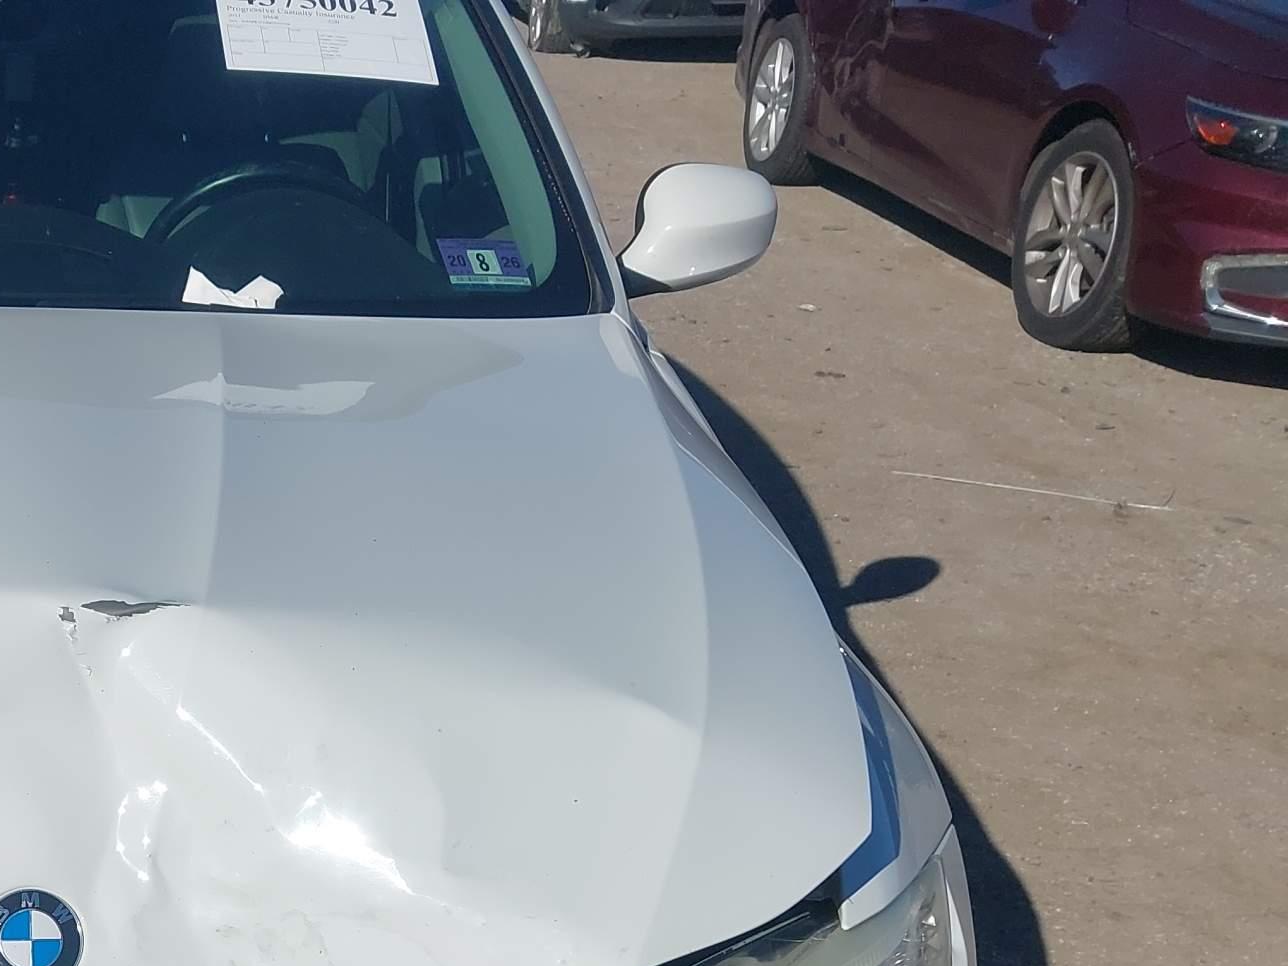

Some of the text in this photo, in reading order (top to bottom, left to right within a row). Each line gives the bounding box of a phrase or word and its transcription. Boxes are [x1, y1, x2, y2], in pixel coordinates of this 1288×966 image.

[226, 5, 275, 14] Progressive
[277, 8, 313, 17] Casualty
[315, 10, 355, 20] Insurance
[239, 0, 397, 17] 0042
[447, 252, 521, 272] 20 8 26
